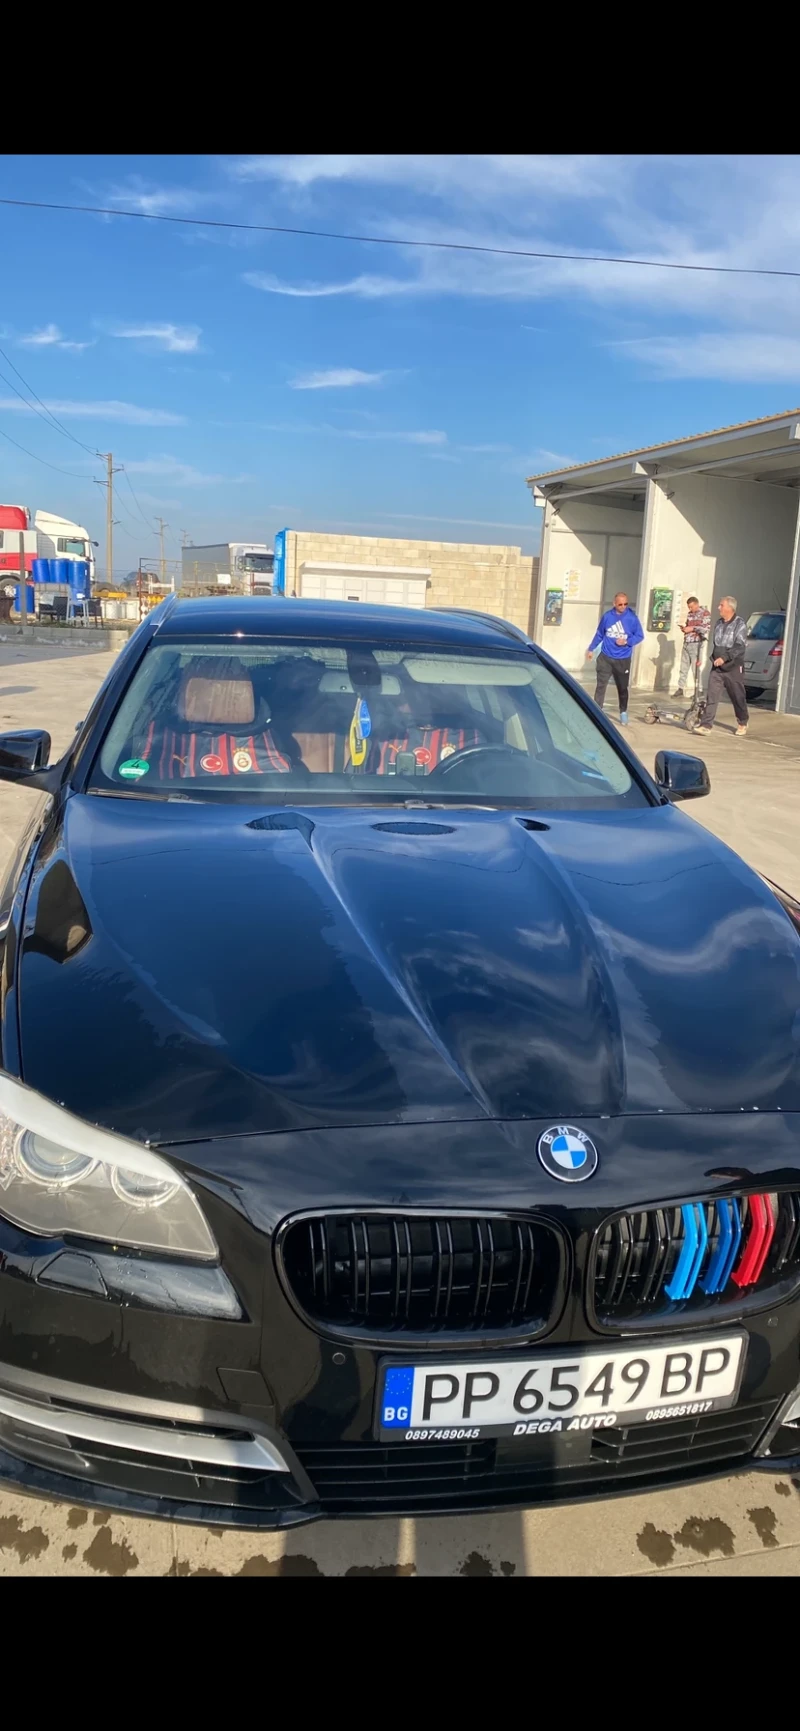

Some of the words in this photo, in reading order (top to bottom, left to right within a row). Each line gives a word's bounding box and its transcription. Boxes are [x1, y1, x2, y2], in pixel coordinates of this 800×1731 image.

[131, 760, 140, 769] 4
[542, 1127, 588, 1144] BMW
[422, 1371, 500, 1421] PP
[513, 1358, 651, 1415] 6549
[660, 1347, 731, 1398] BP
[384, 1406, 408, 1422] BG
[405, 1428, 480, 1440] 0897489045
[513, 1420, 562, 1435] DEGA
[566, 1414, 618, 1430] AUTO
[645, 1400, 713, 1420] 0895651817
